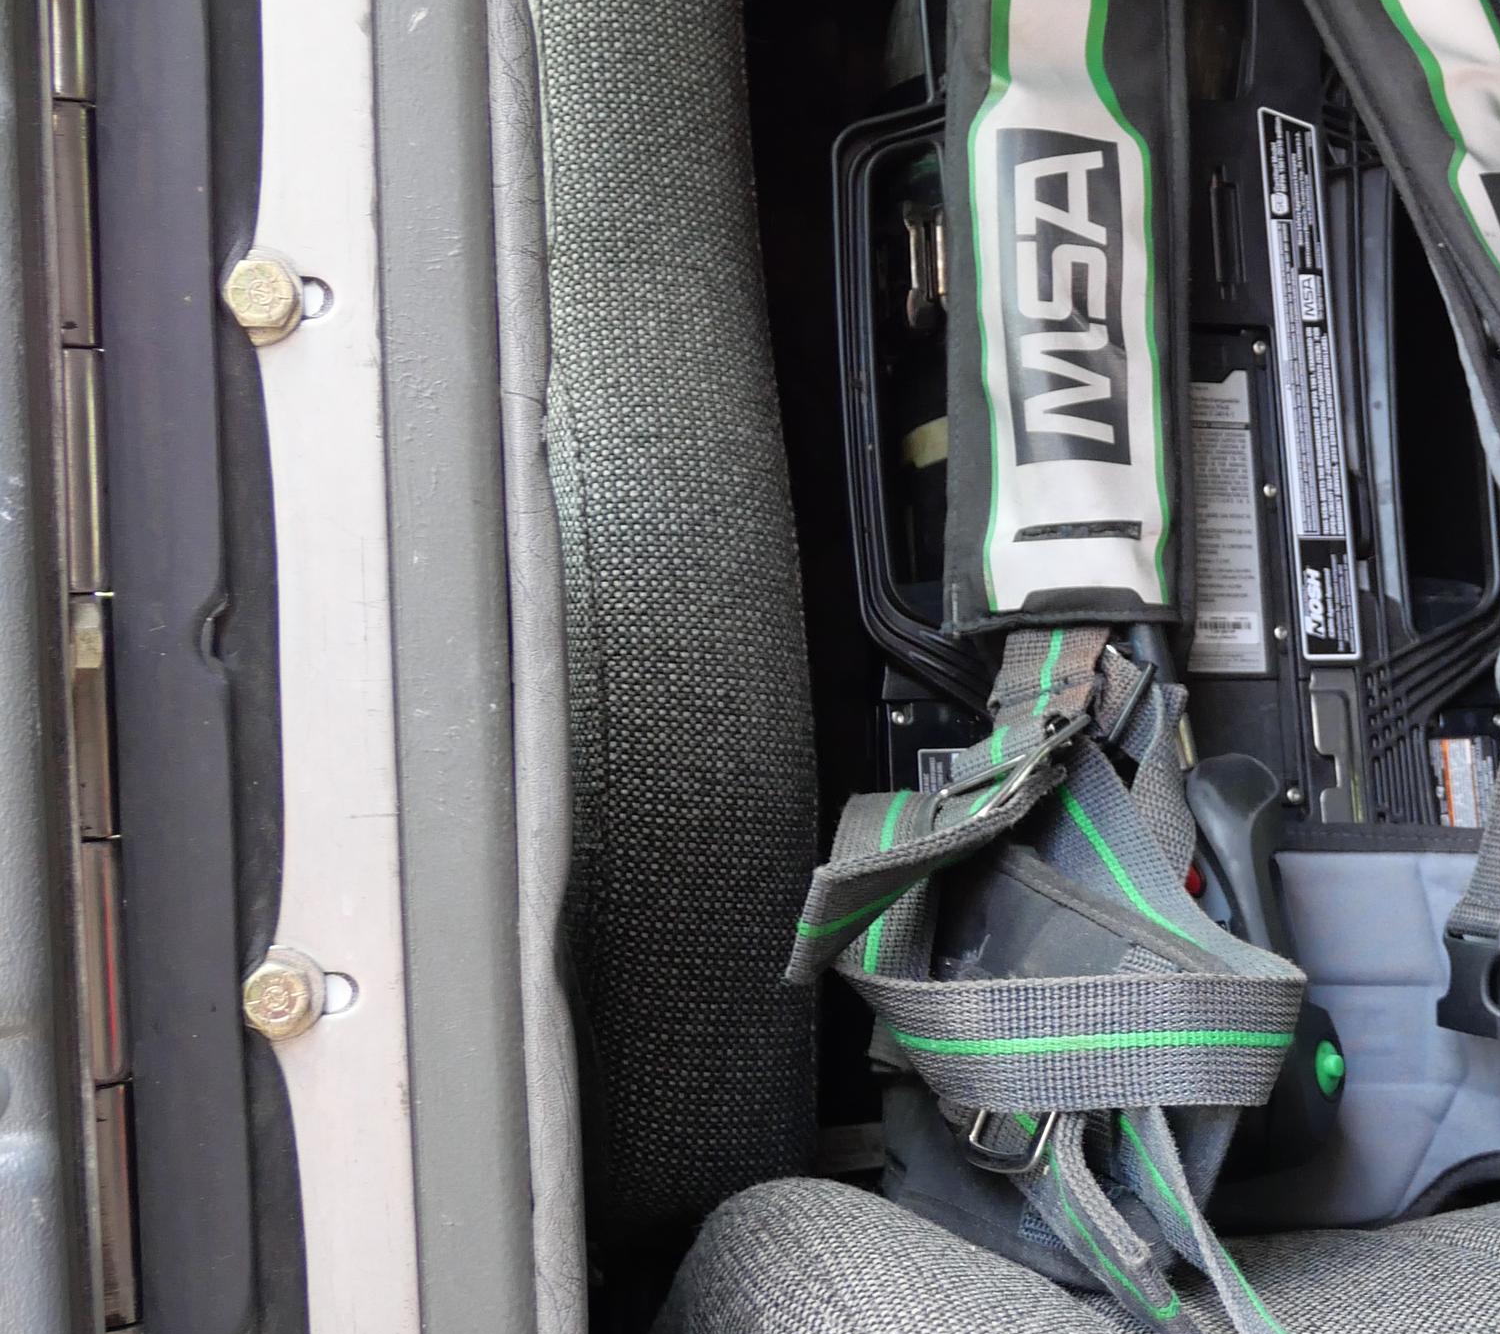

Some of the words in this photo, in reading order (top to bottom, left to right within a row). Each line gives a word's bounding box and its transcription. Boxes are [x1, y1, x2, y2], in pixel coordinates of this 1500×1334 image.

[1014, 149, 1115, 446] MSA
[1302, 276, 1315, 317] MSA
[1305, 567, 1325, 639] NIOSH
